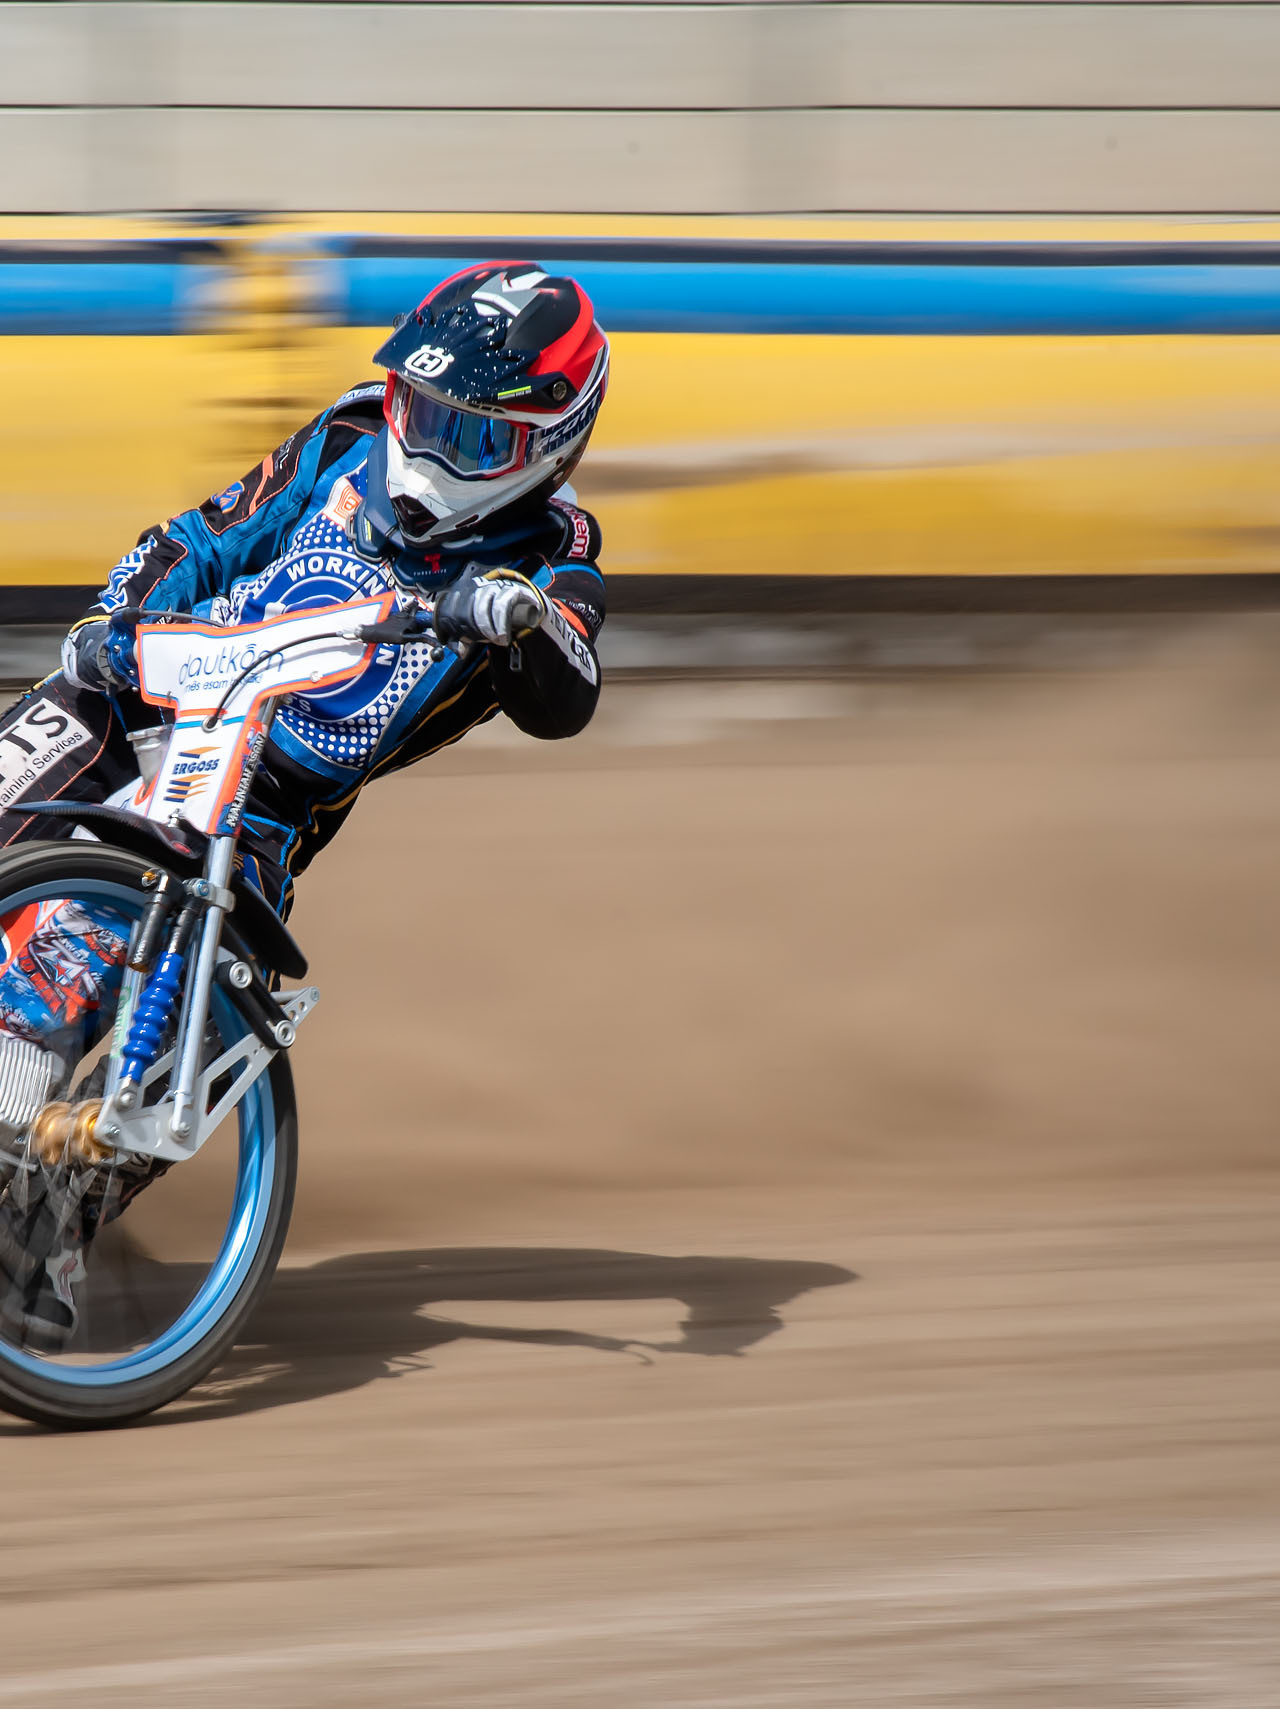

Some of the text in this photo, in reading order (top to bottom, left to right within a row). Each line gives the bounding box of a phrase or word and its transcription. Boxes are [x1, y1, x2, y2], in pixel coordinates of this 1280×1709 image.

[286, 556, 385, 597] WORKIN
[32, 732, 83, 769] Services
[172, 758, 221, 775] ERGOSS
